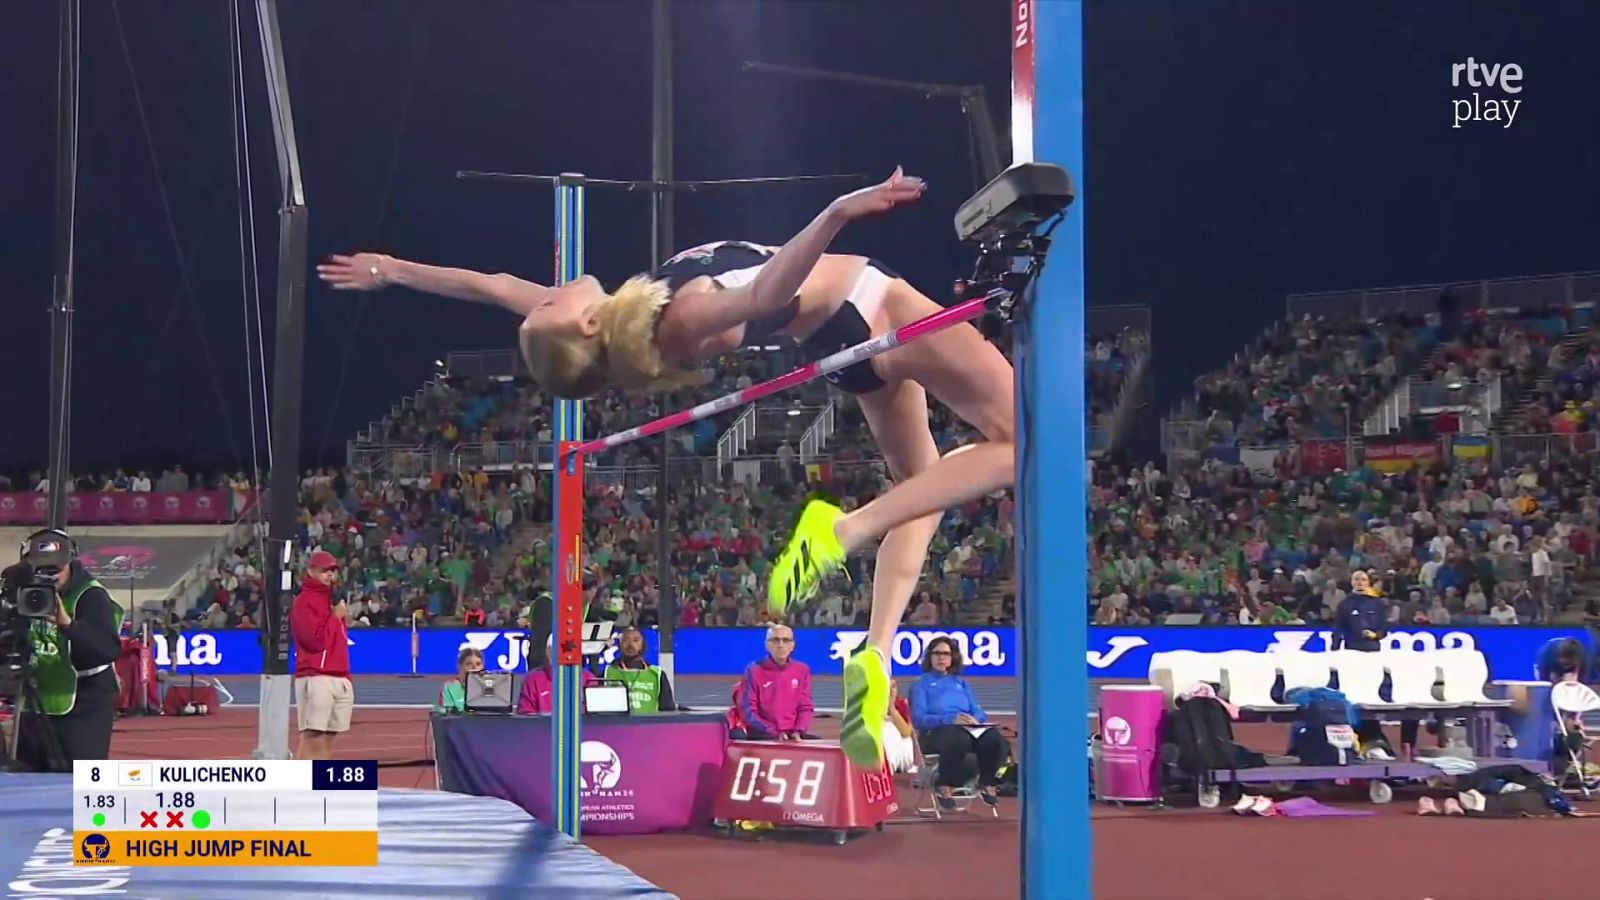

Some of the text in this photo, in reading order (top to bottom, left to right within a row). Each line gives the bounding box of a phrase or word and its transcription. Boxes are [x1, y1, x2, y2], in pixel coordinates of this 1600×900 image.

[1016, 0, 1028, 47] No
[730, 757, 825, 806] 0:58
[791, 811, 825, 823] OMEGA
